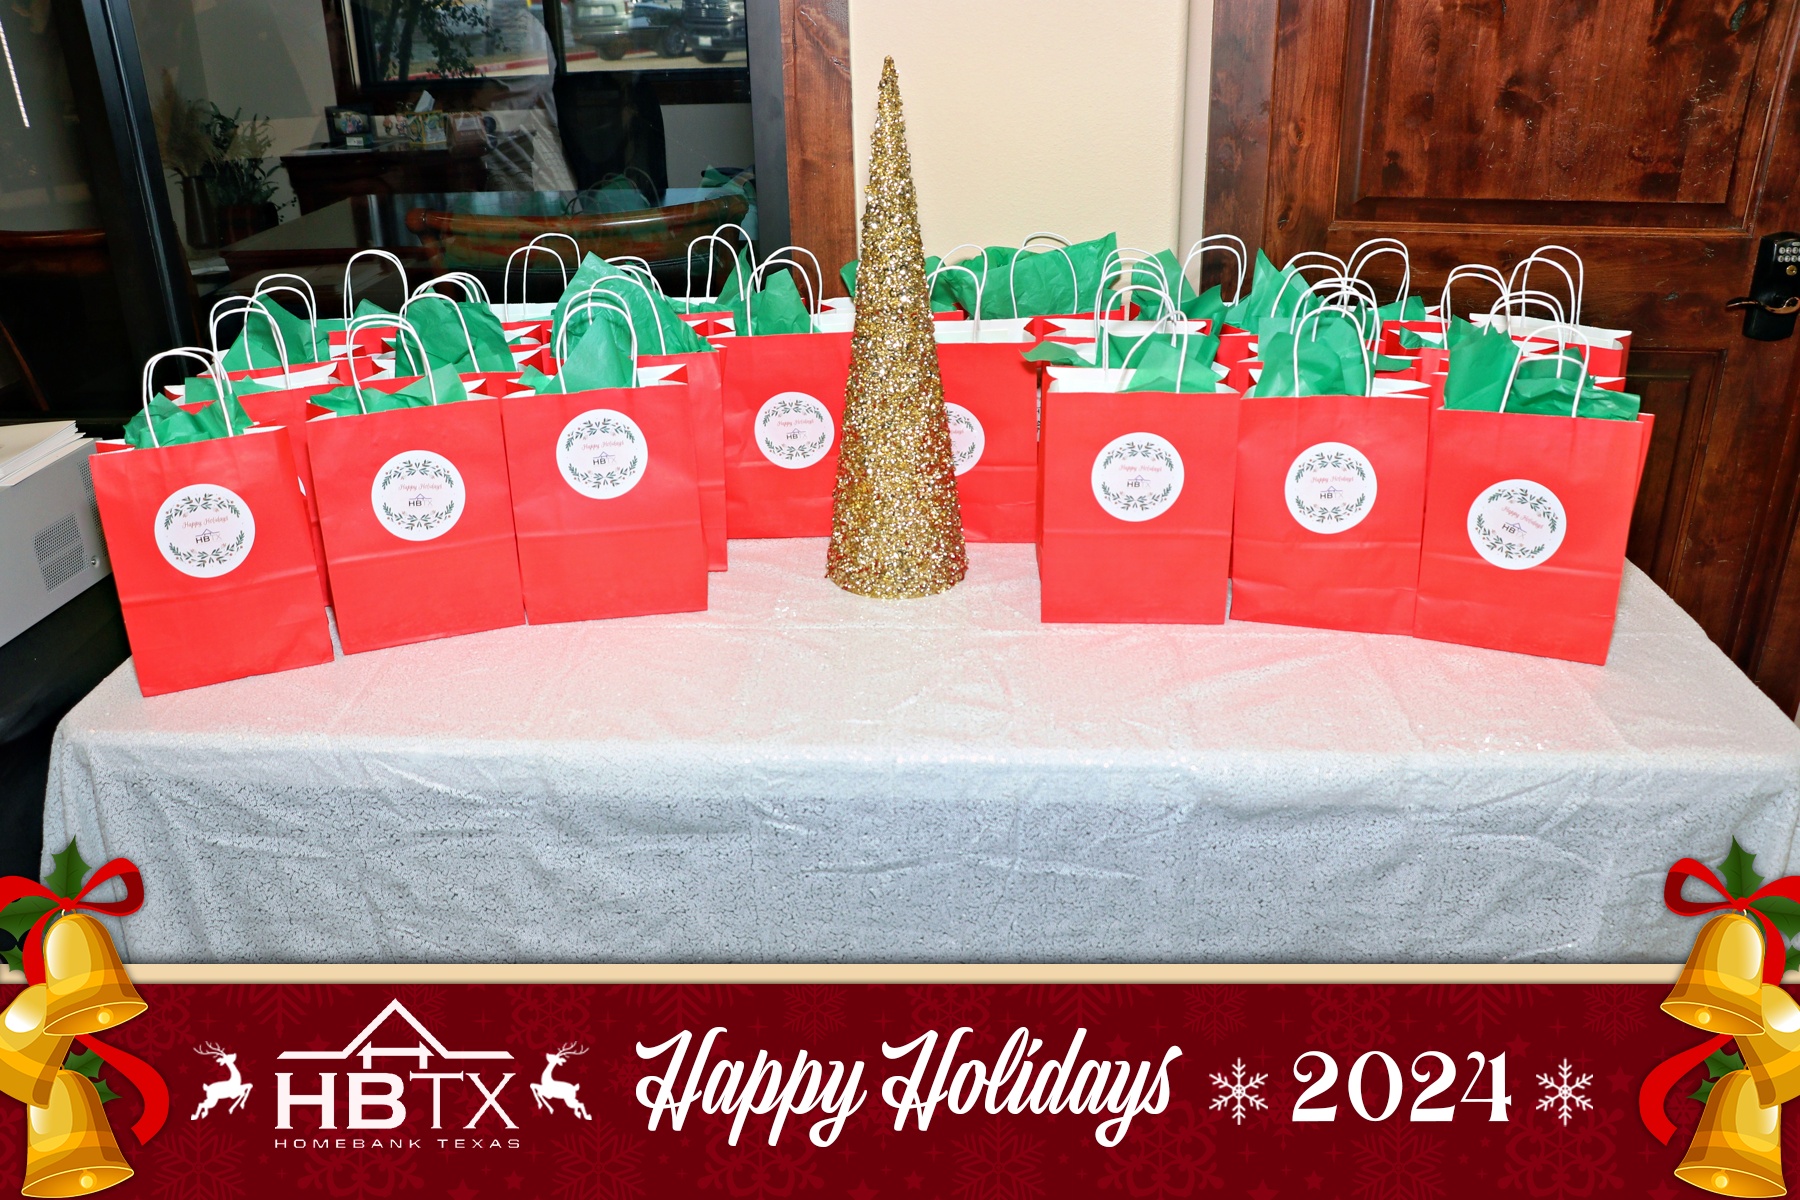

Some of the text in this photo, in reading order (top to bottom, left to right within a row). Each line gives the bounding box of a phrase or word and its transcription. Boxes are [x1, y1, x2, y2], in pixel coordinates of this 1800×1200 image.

[399, 483, 417, 491] Happy
[182, 516, 229, 529] Happy Holidays
